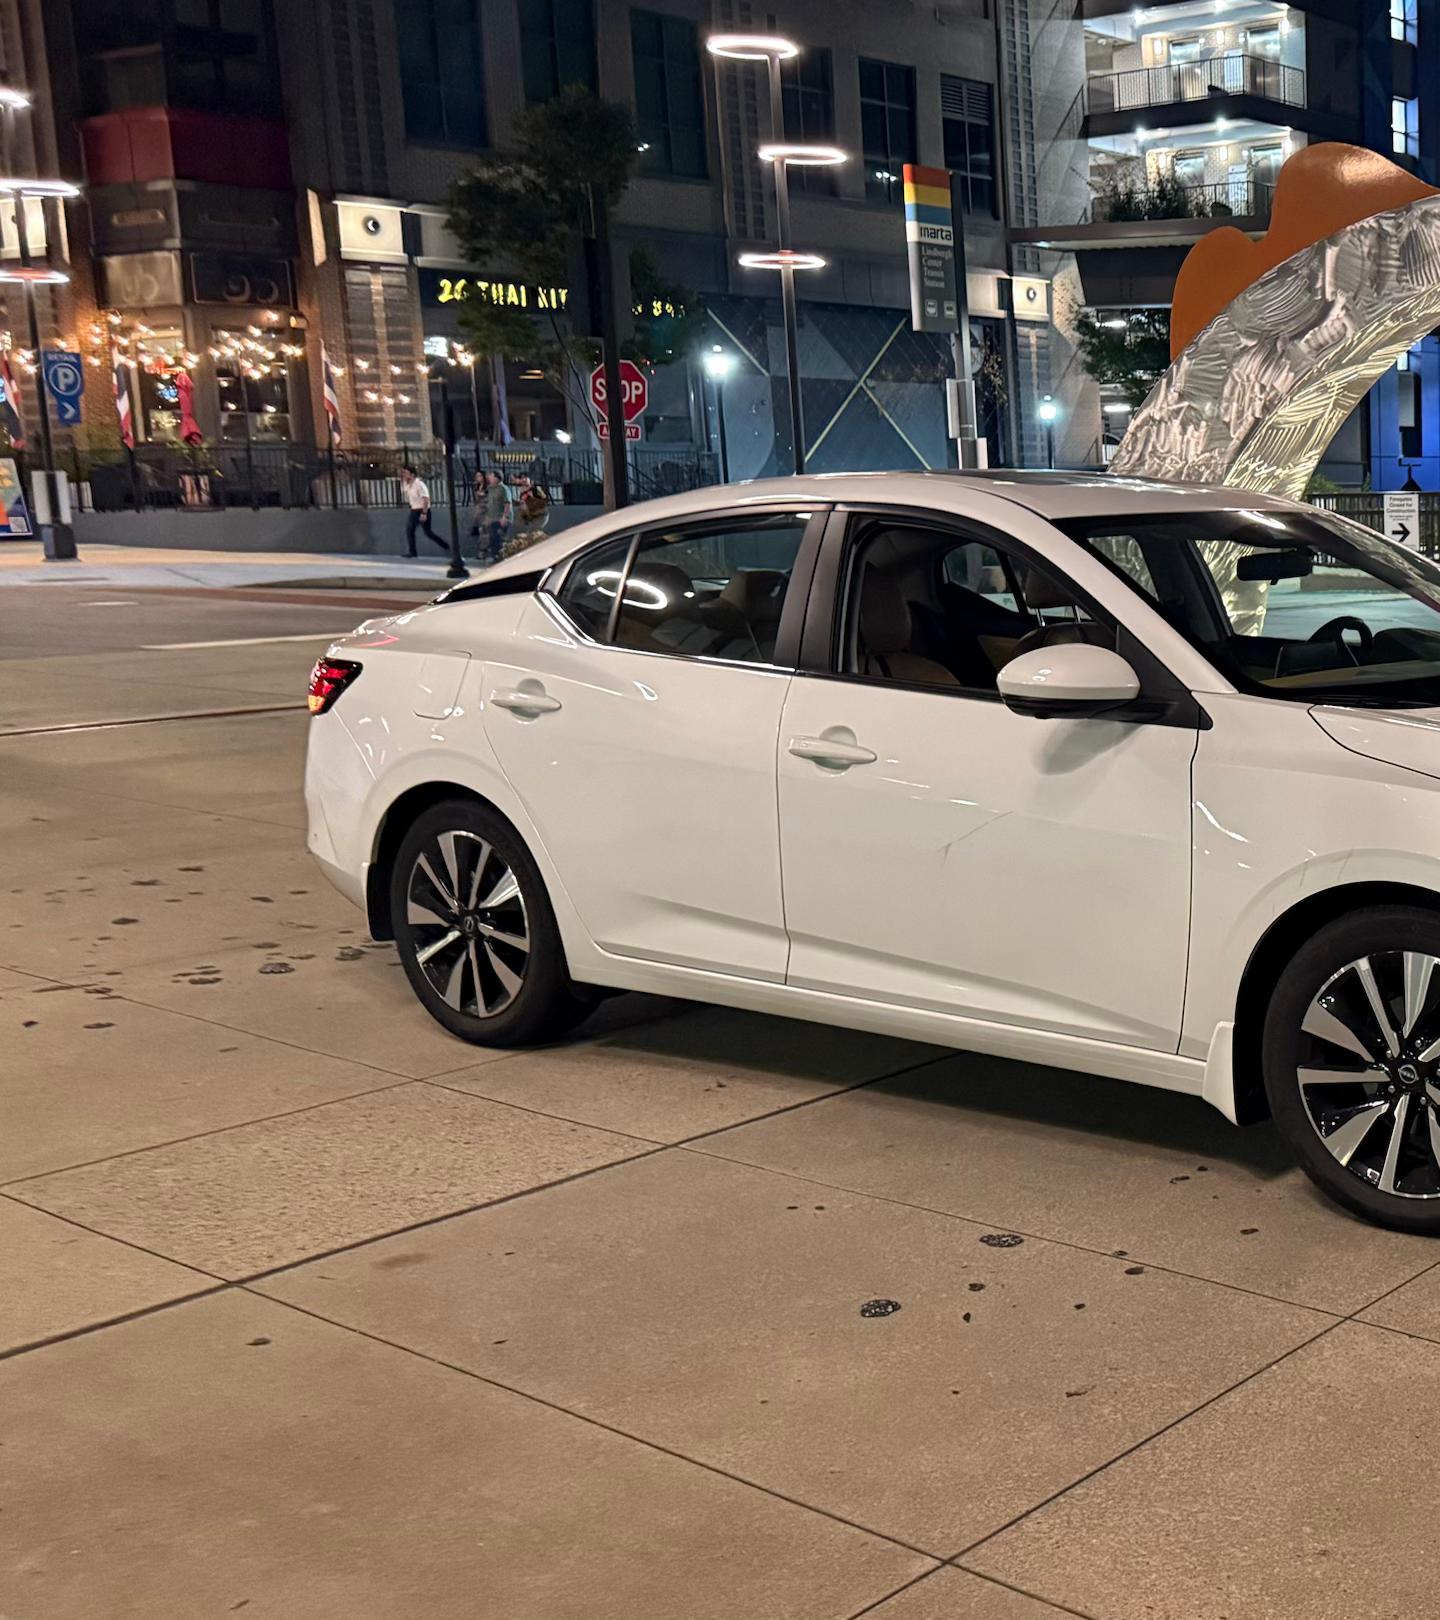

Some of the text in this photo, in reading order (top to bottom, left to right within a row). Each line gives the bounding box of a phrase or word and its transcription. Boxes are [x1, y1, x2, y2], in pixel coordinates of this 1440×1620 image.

[920, 226, 952, 241] marta
[922, 257, 943, 268] Center
[923, 267, 945, 278] Transit
[477, 280, 527, 307] THAI
[594, 378, 643, 404] SOP
